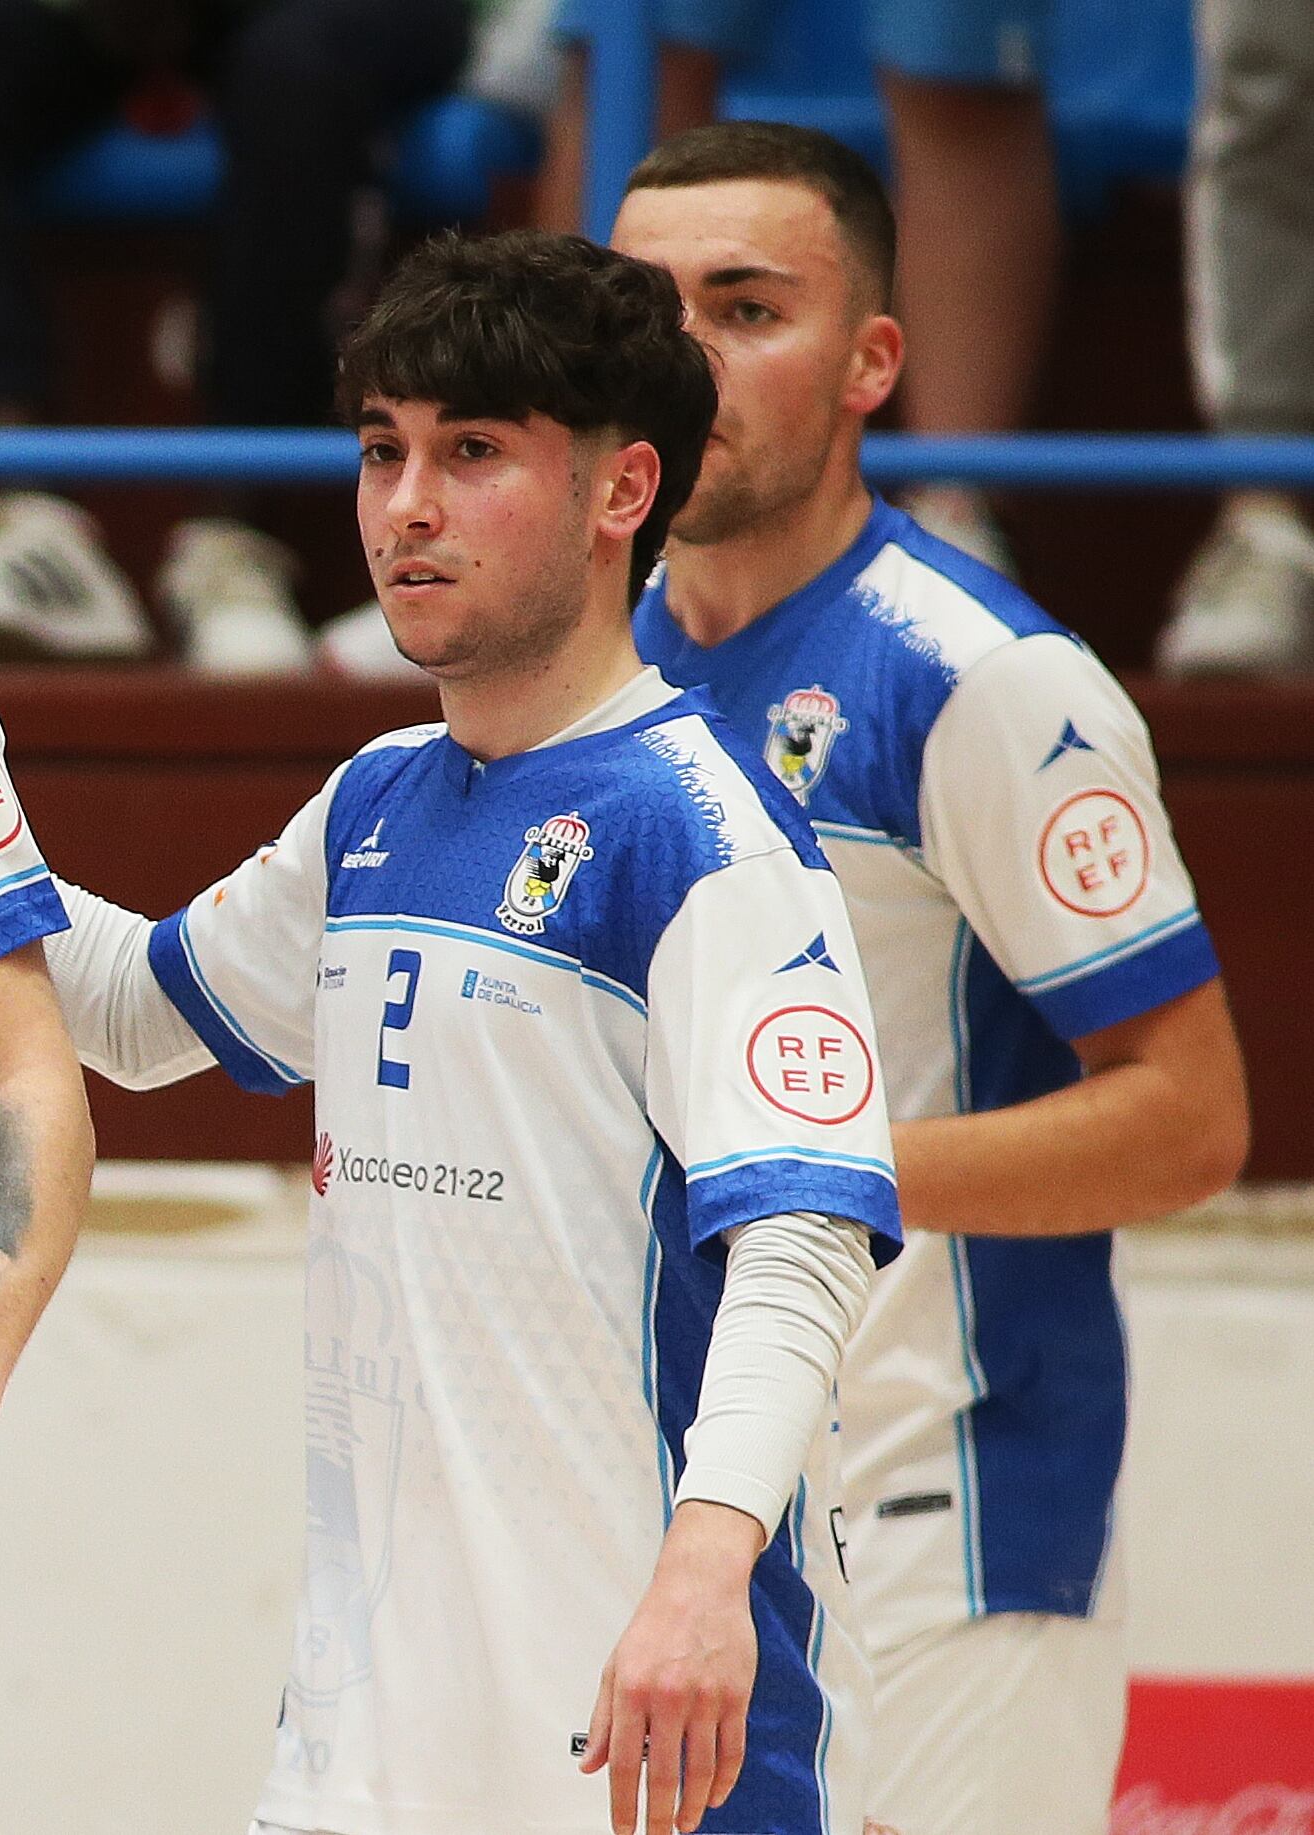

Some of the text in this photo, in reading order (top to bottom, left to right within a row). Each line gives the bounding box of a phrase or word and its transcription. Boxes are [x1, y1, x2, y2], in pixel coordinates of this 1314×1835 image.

[481, 976, 517, 995] XUNTA
[477, 988, 543, 1015] DE GALICIA
[378, 949, 422, 1091] 2
